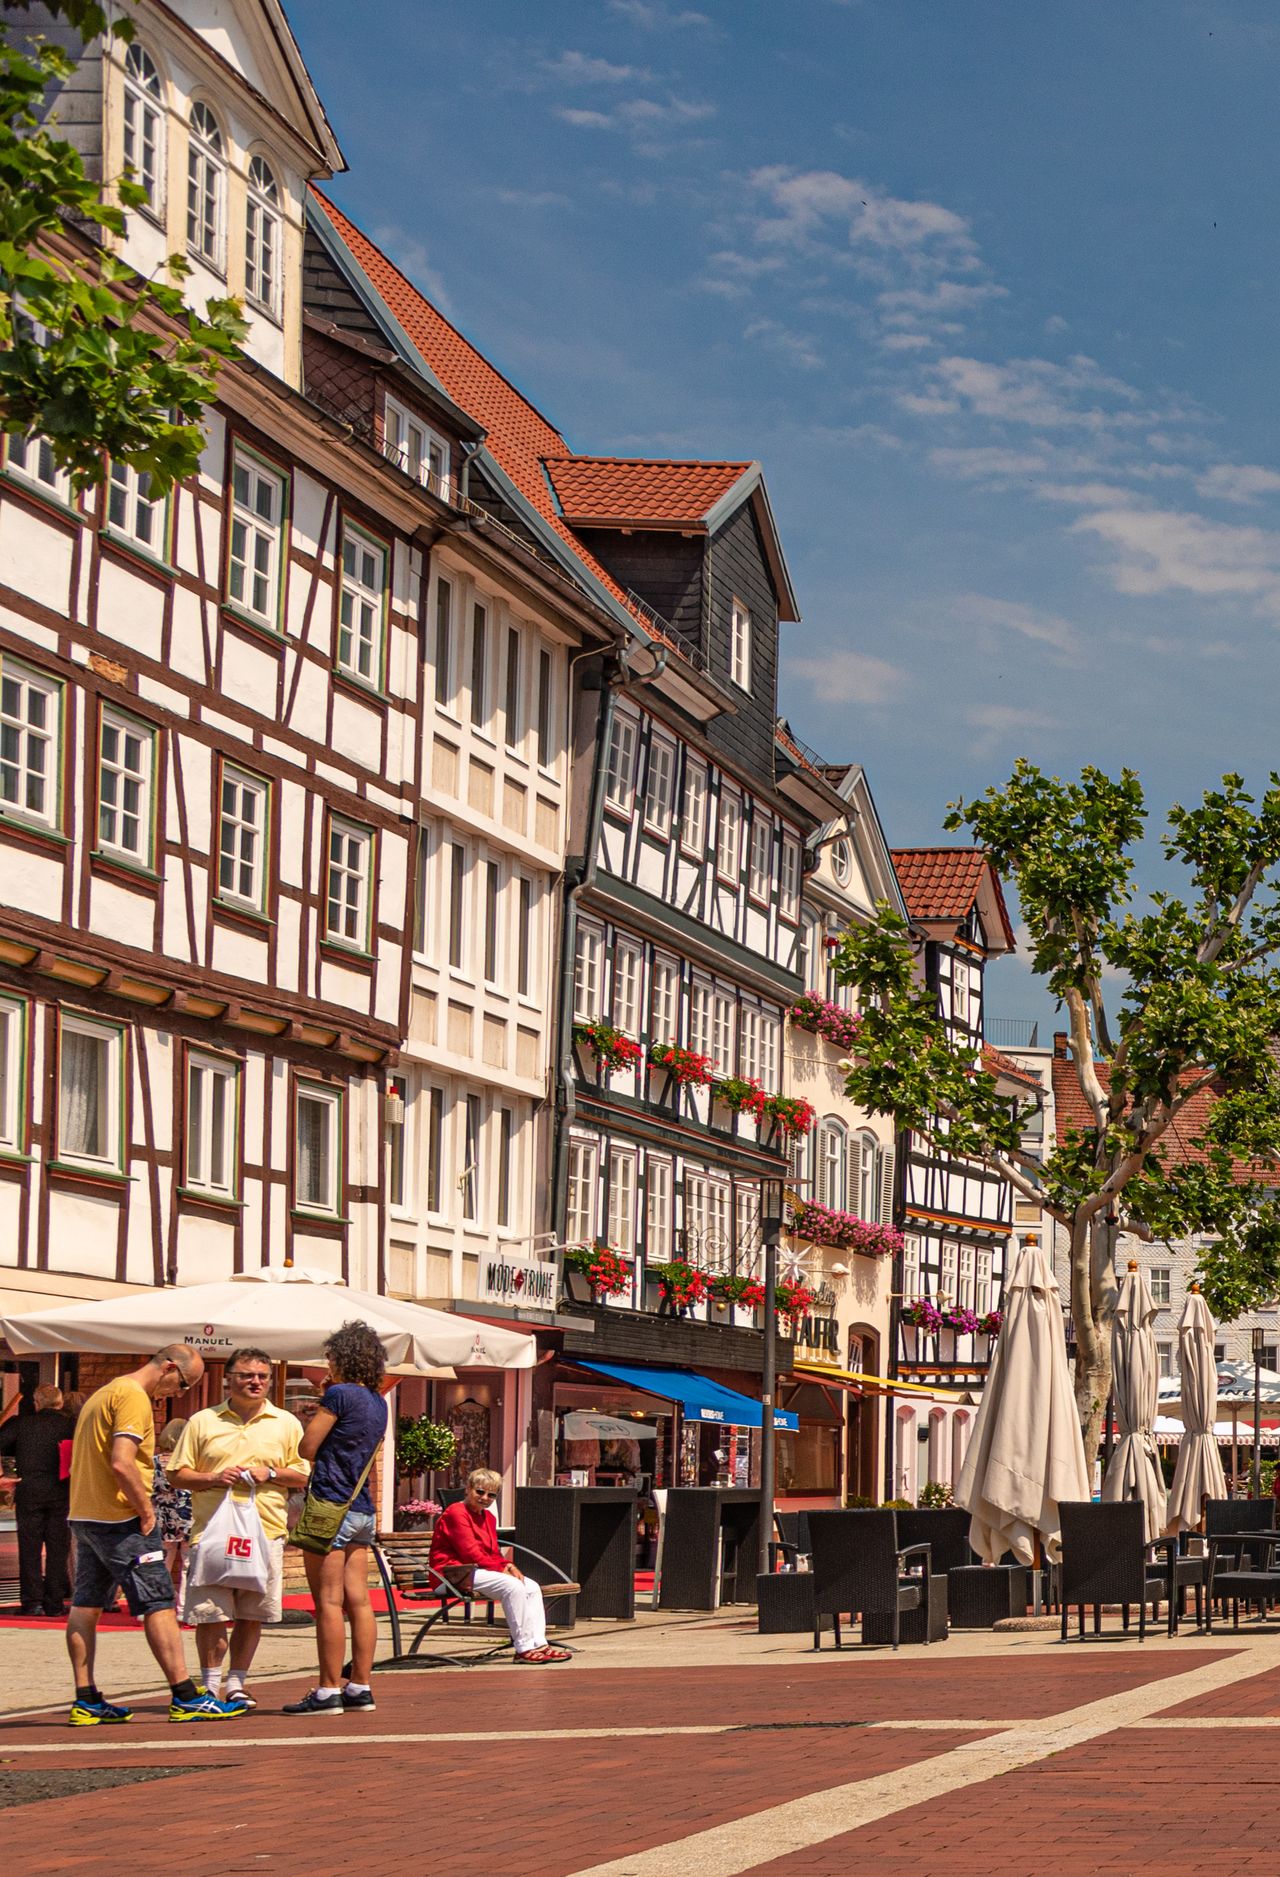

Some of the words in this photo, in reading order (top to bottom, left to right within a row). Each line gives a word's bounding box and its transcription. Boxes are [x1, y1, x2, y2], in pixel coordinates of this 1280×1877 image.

[487, 1262, 516, 1294] MODE
[523, 1268, 555, 1300] TRUHE
[184, 1336, 233, 1346] MANUEL
[227, 1536, 251, 1557] RS
